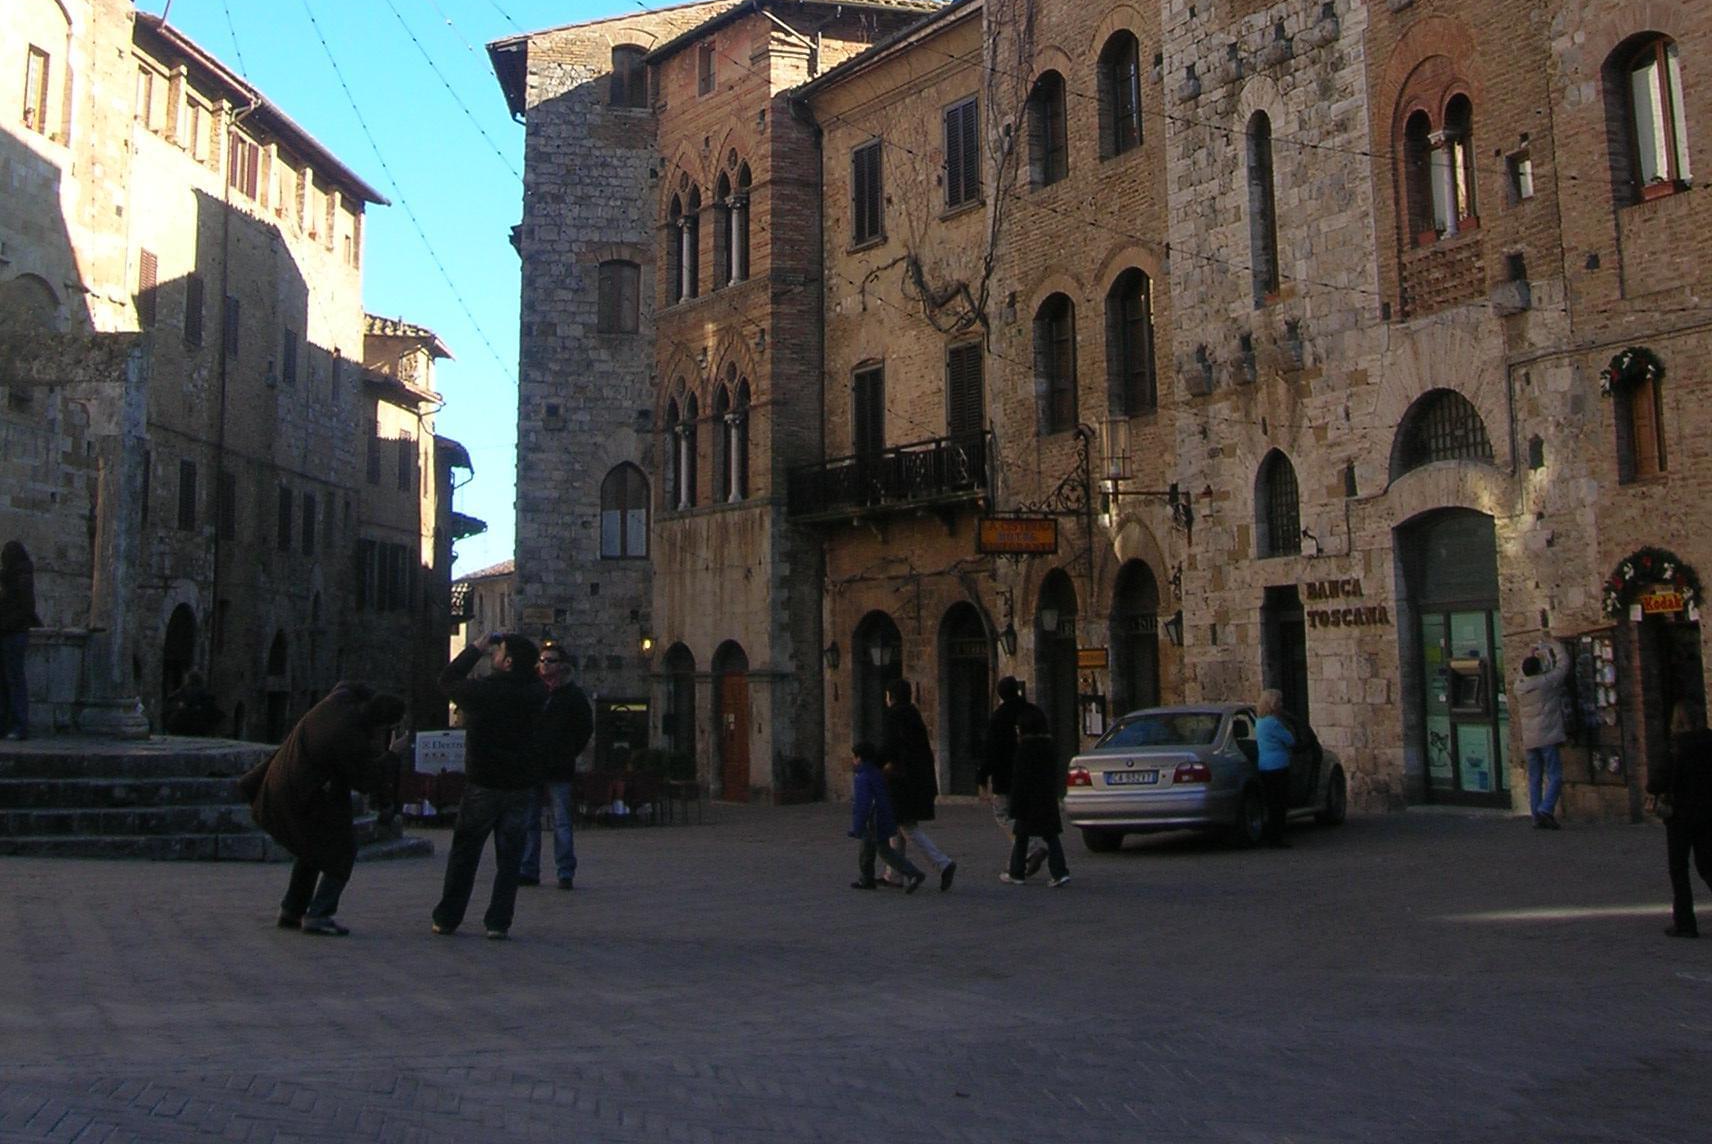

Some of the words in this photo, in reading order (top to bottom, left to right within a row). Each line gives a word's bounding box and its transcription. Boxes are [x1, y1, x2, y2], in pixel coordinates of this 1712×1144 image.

[1306, 578, 1364, 599] BANCA
[1643, 594, 1682, 611] Kodak
[1307, 605, 1391, 629] TOSCANA
[432, 740, 465, 749] Electro
